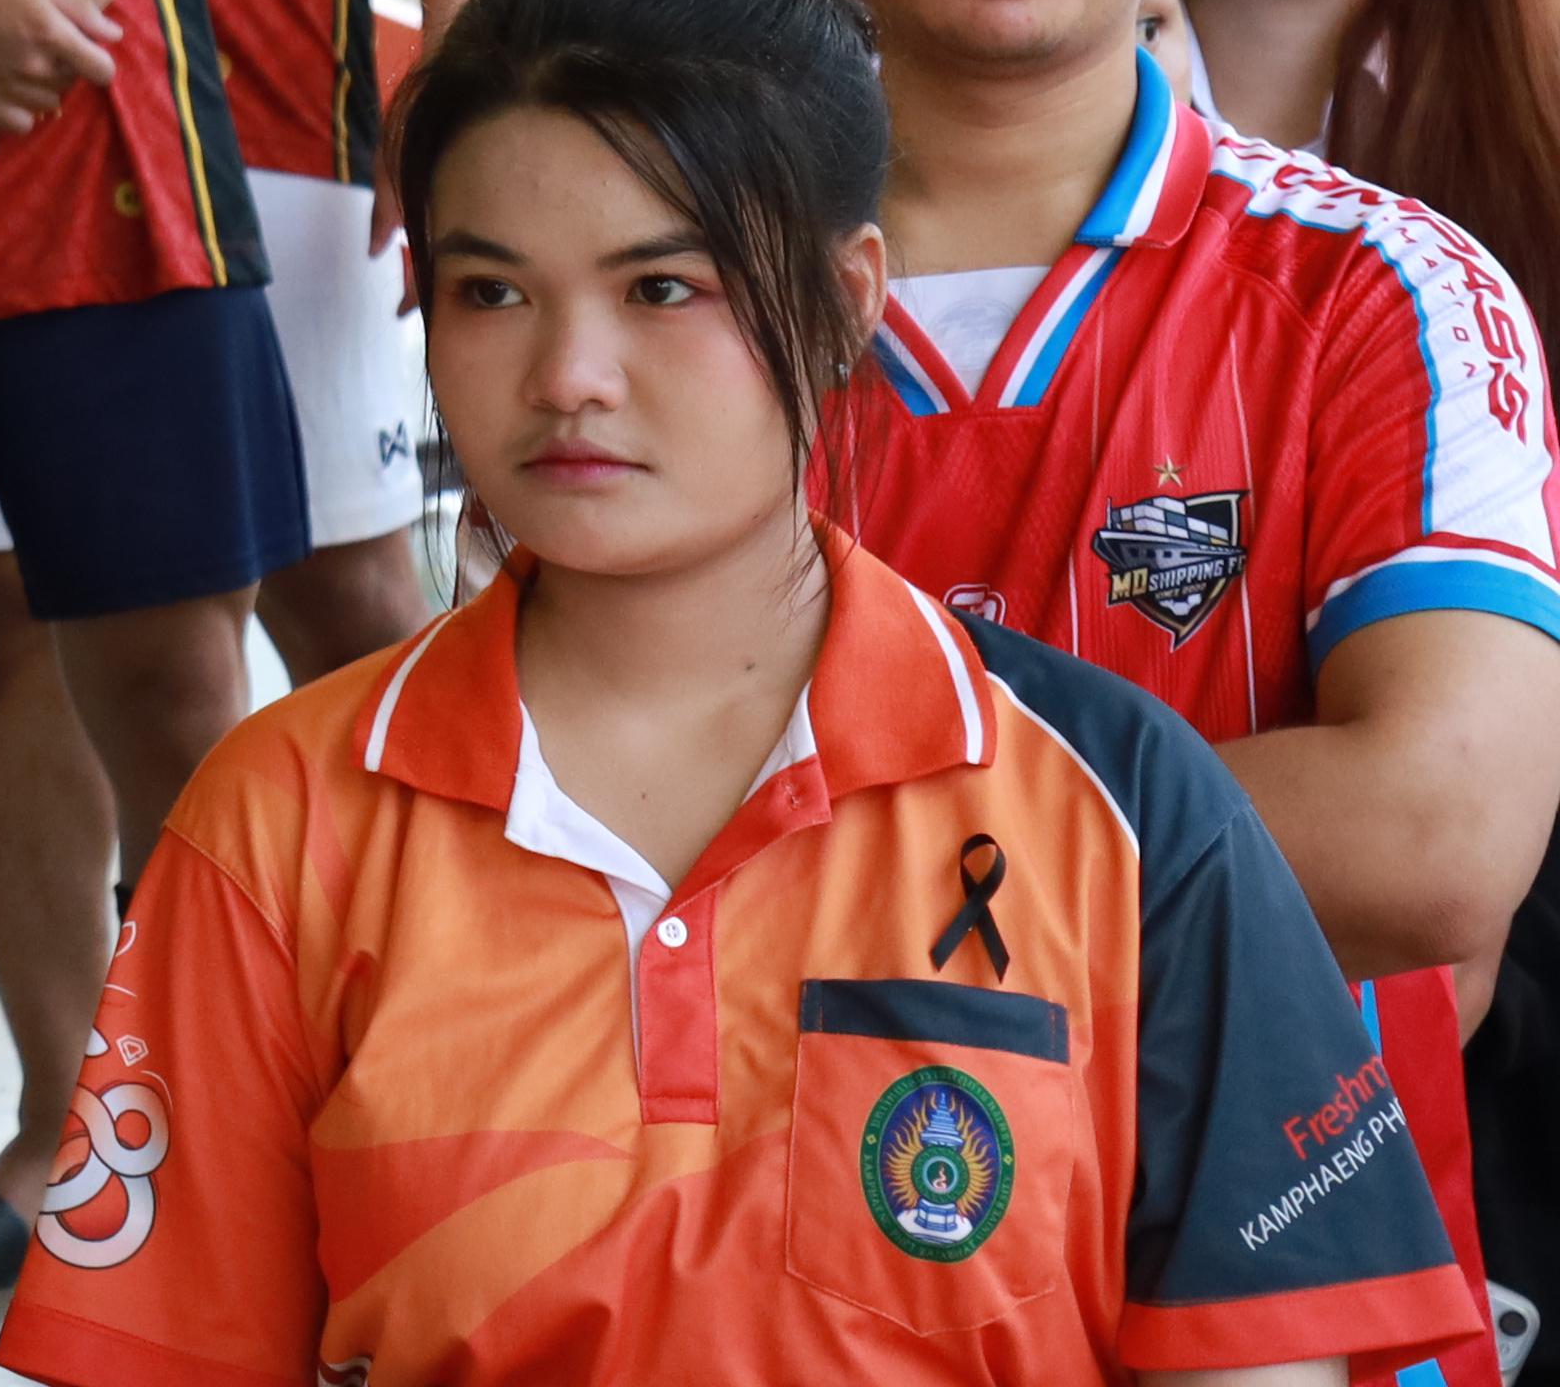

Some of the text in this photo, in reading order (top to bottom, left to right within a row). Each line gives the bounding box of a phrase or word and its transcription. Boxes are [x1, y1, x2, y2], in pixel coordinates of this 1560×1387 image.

[1148, 558, 1225, 593] SHIPPING
[1282, 1054, 1387, 1162] Freshm
[1239, 1096, 1407, 1252] KAMPHAENG PH
